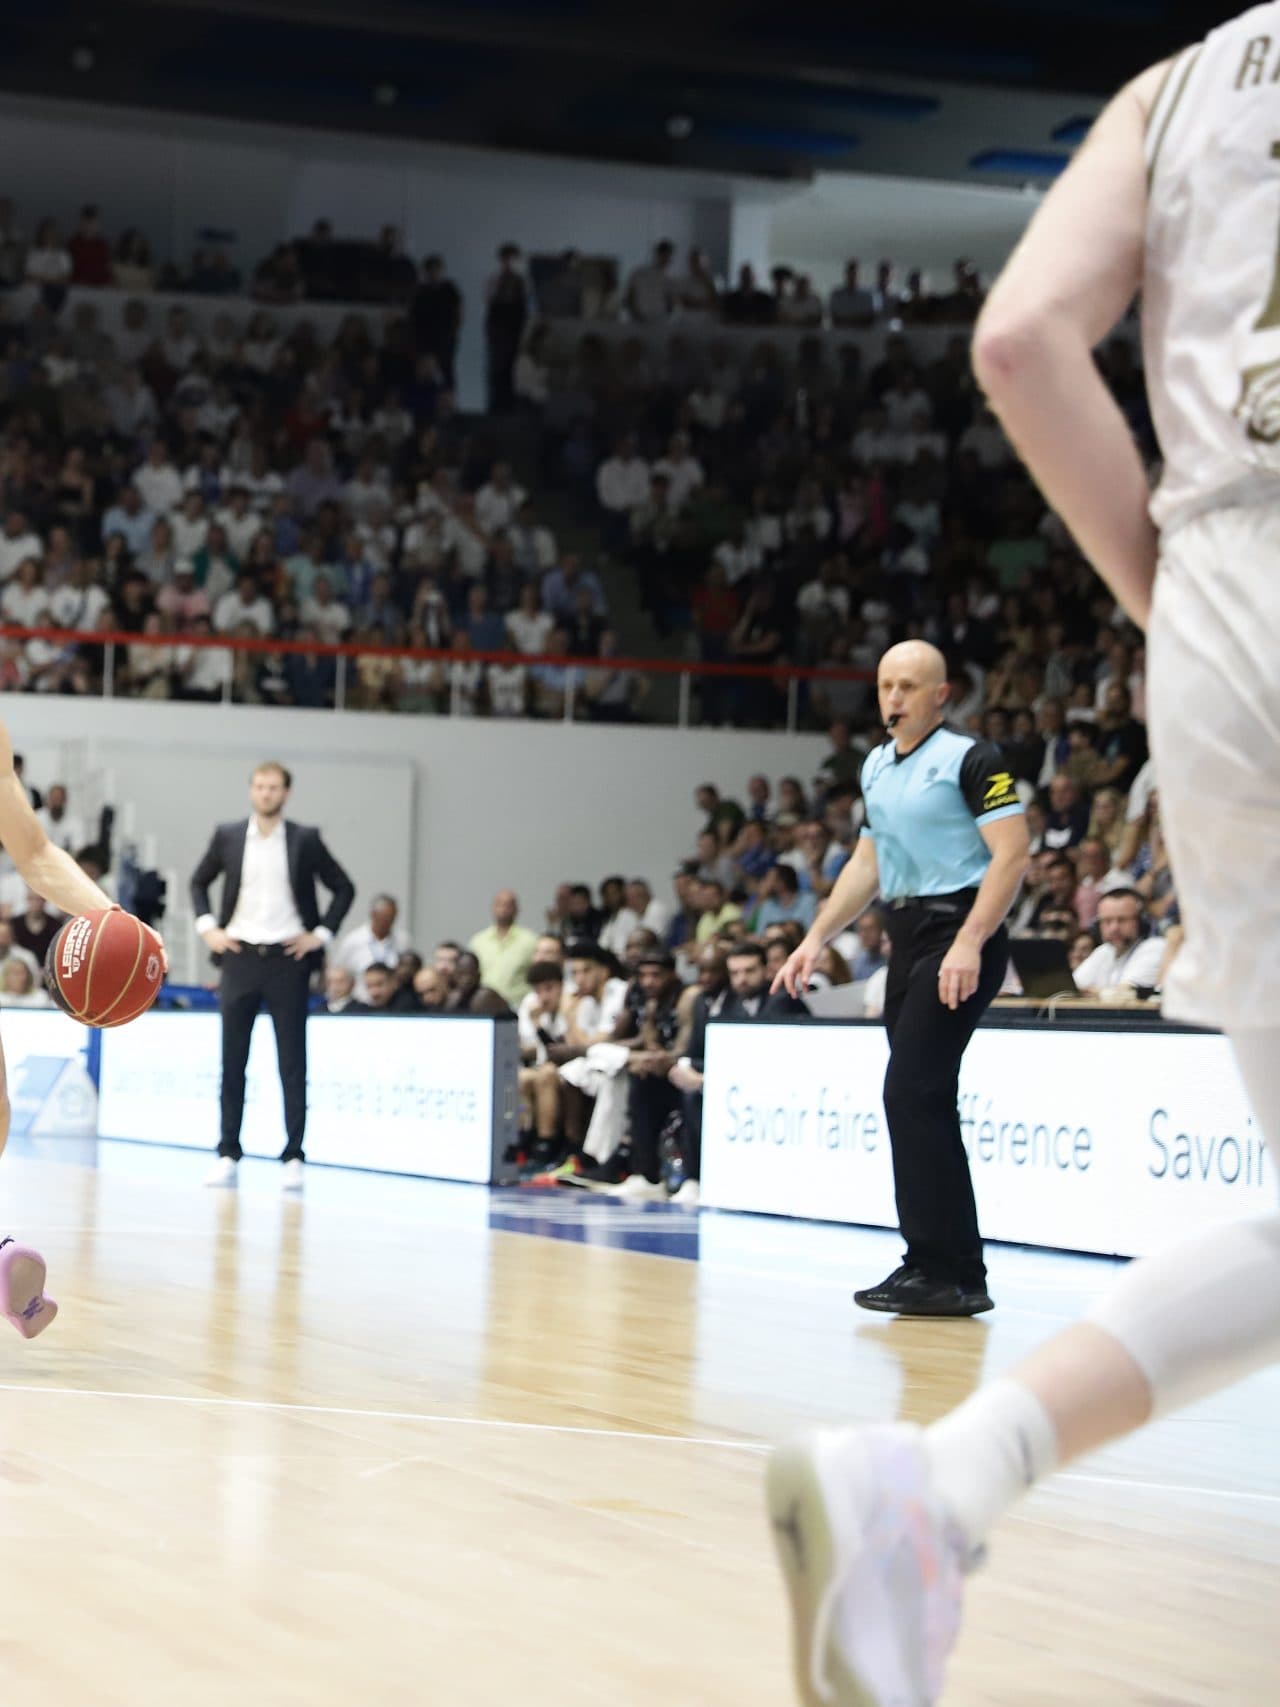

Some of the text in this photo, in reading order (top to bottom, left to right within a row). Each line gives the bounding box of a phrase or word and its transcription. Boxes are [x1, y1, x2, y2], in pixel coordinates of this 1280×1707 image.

[724, 1085, 1267, 1187] Savoir faire fférence Savoir
